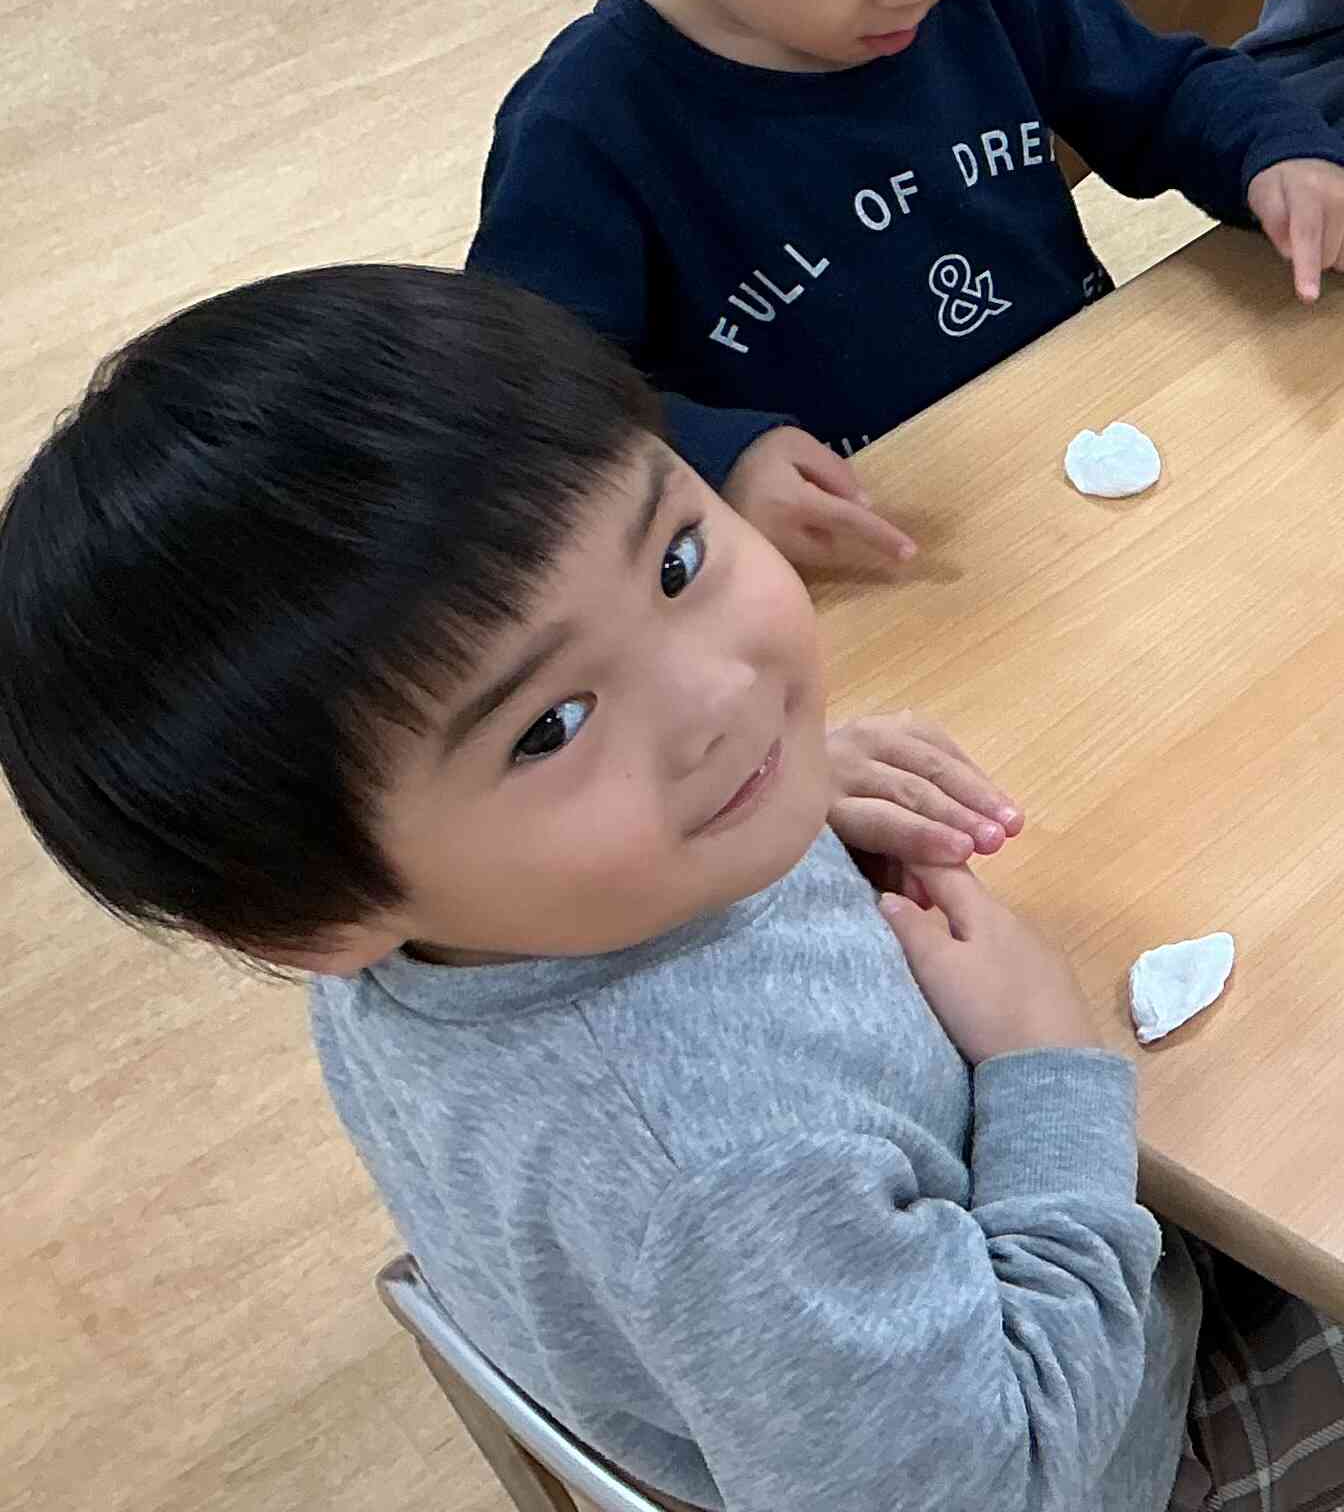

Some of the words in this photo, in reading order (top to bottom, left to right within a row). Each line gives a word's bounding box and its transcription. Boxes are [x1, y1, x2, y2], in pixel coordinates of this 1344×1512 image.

[708, 243, 830, 354] FULL
[854, 170, 919, 232] OF
[952, 120, 1056, 188] DRE
[928, 253, 1013, 337] &
